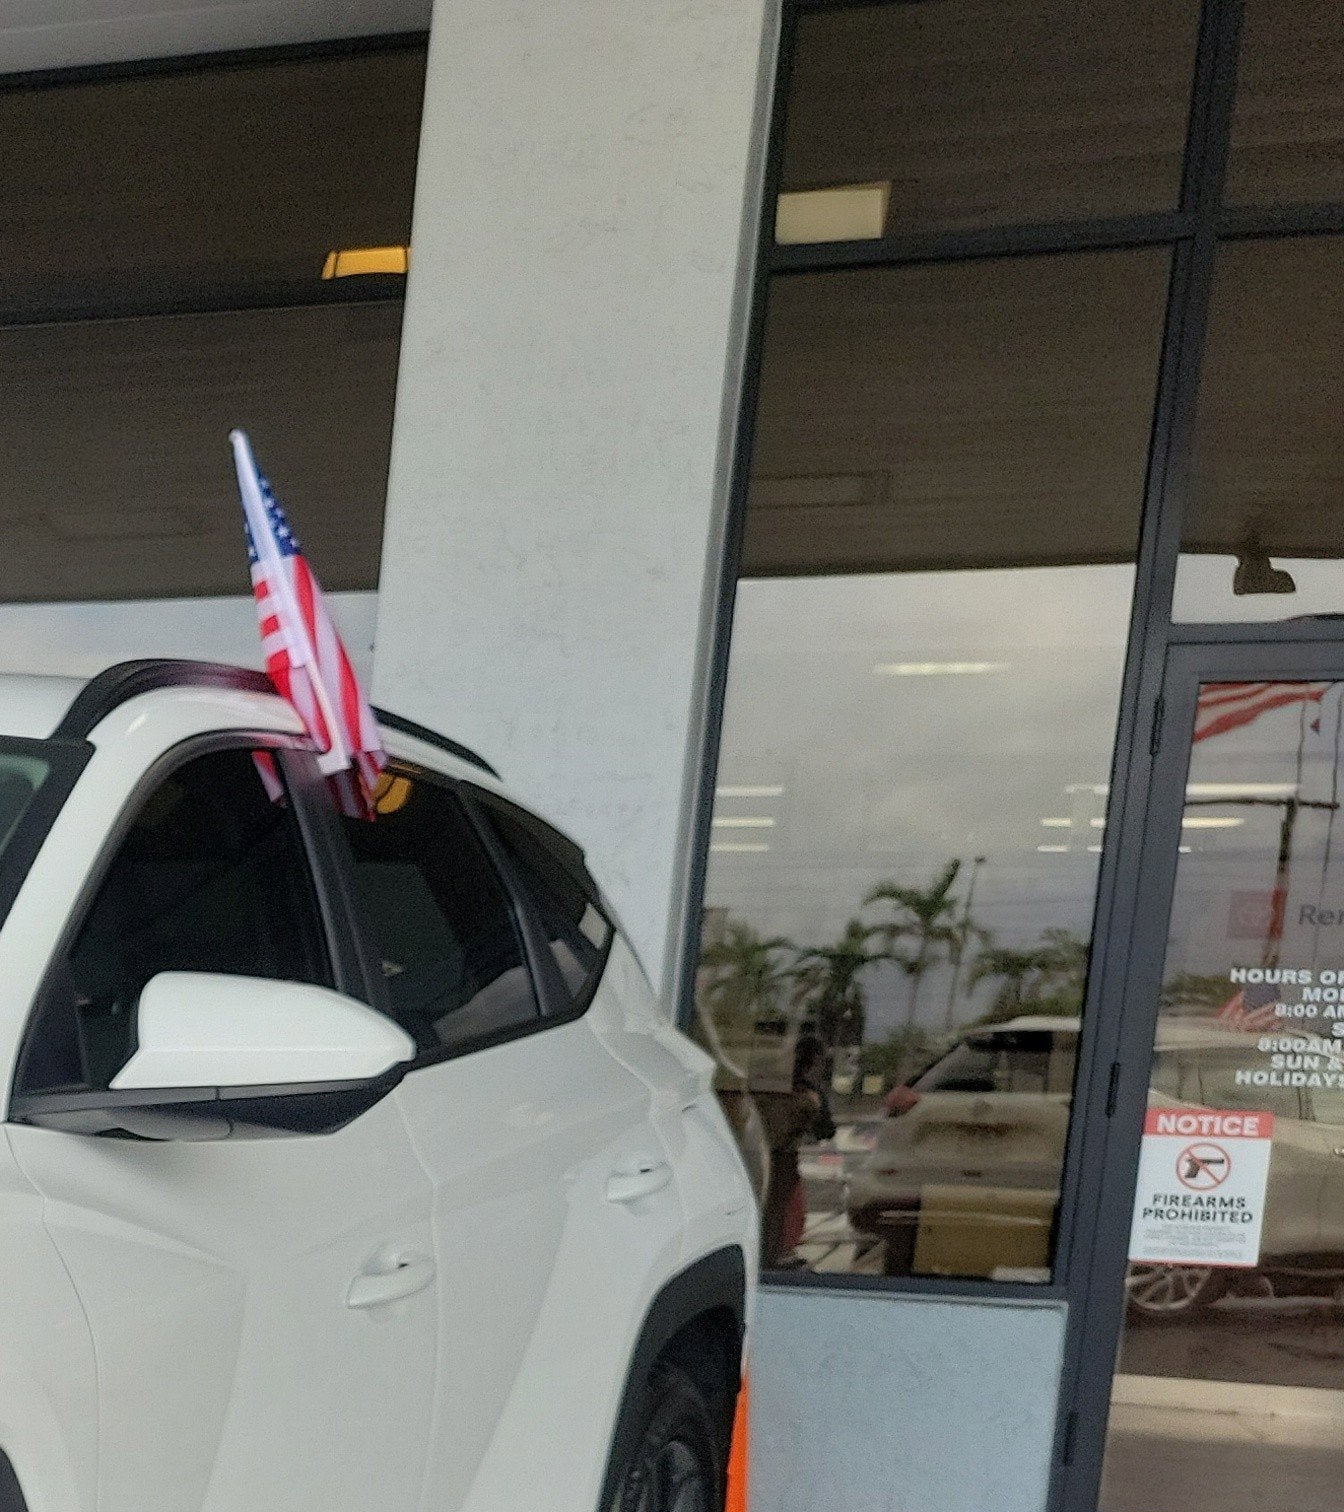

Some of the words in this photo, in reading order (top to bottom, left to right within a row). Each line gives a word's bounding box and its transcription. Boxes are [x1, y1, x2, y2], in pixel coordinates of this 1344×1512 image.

[1229, 967, 1313, 985] HOURS
[1302, 987, 1344, 1003] MO
[1270, 1053, 1320, 1070] SUN
[1157, 1114, 1259, 1136] NOTICE
[1152, 1193, 1247, 1209] FIREARMS
[1142, 1207, 1254, 1224] PROHIBITED
